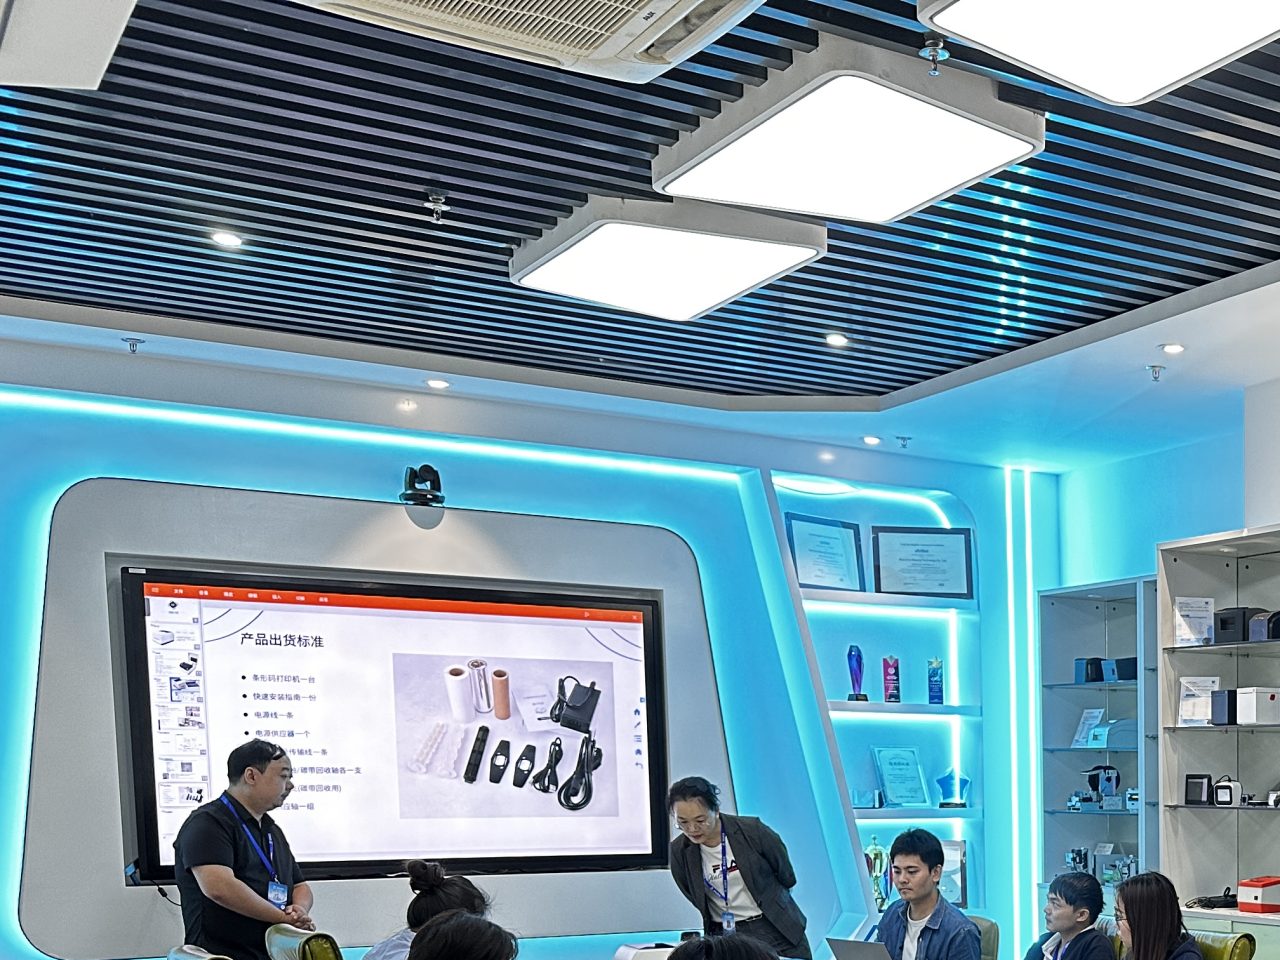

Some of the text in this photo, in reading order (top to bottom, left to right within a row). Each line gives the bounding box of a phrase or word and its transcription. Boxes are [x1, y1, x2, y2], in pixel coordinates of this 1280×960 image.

[240, 632, 325, 648] 产品出货标准
[252, 674, 316, 684] 条形码打印机一台
[252, 692, 317, 702] 快速安装指南一份
[254, 711, 294, 719] 电源线一条
[255, 729, 311, 738] 电源供应器一个
[286, 748, 328, 756] 传输线一条
[281, 802, 315, 811] 应轴一组
